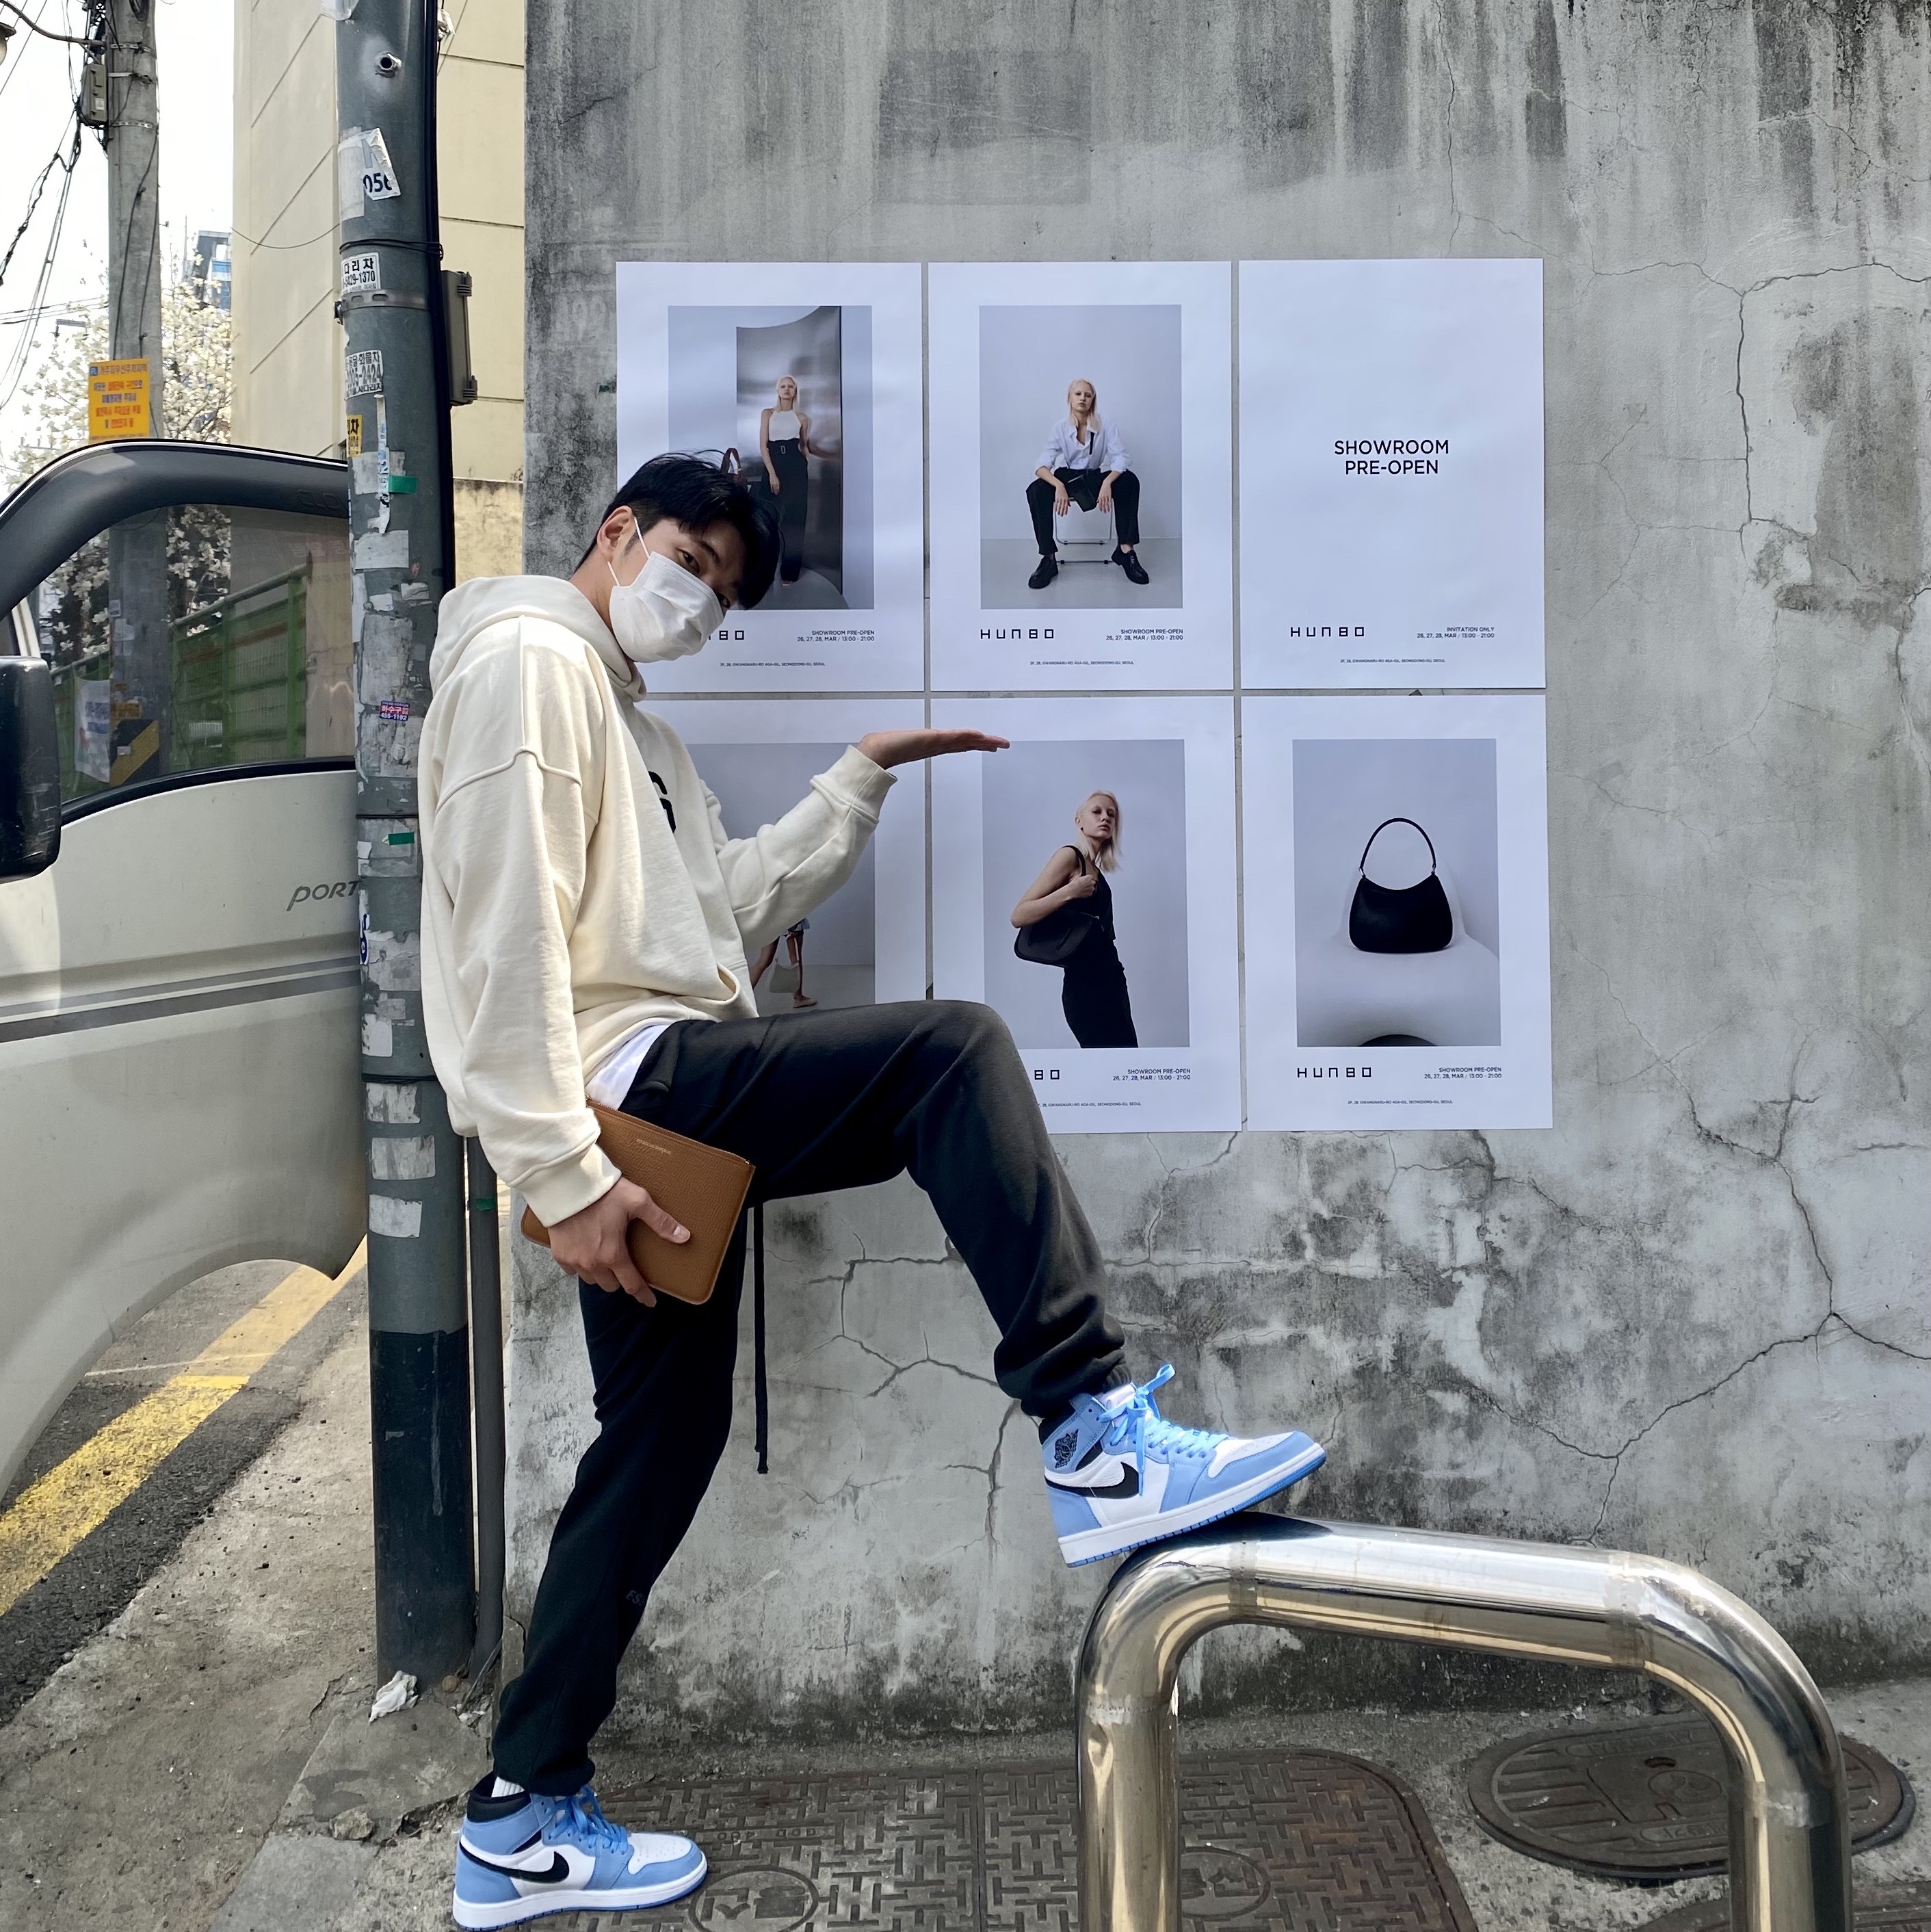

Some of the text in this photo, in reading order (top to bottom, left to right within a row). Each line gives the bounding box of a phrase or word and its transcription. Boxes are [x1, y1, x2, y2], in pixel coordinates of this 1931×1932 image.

[343, 257, 373, 274] 다리차
[1334, 439, 1449, 455] SHOWROOM
[1345, 459, 1439, 475] PRE-OPEN
[286, 880, 360, 911] PORT
